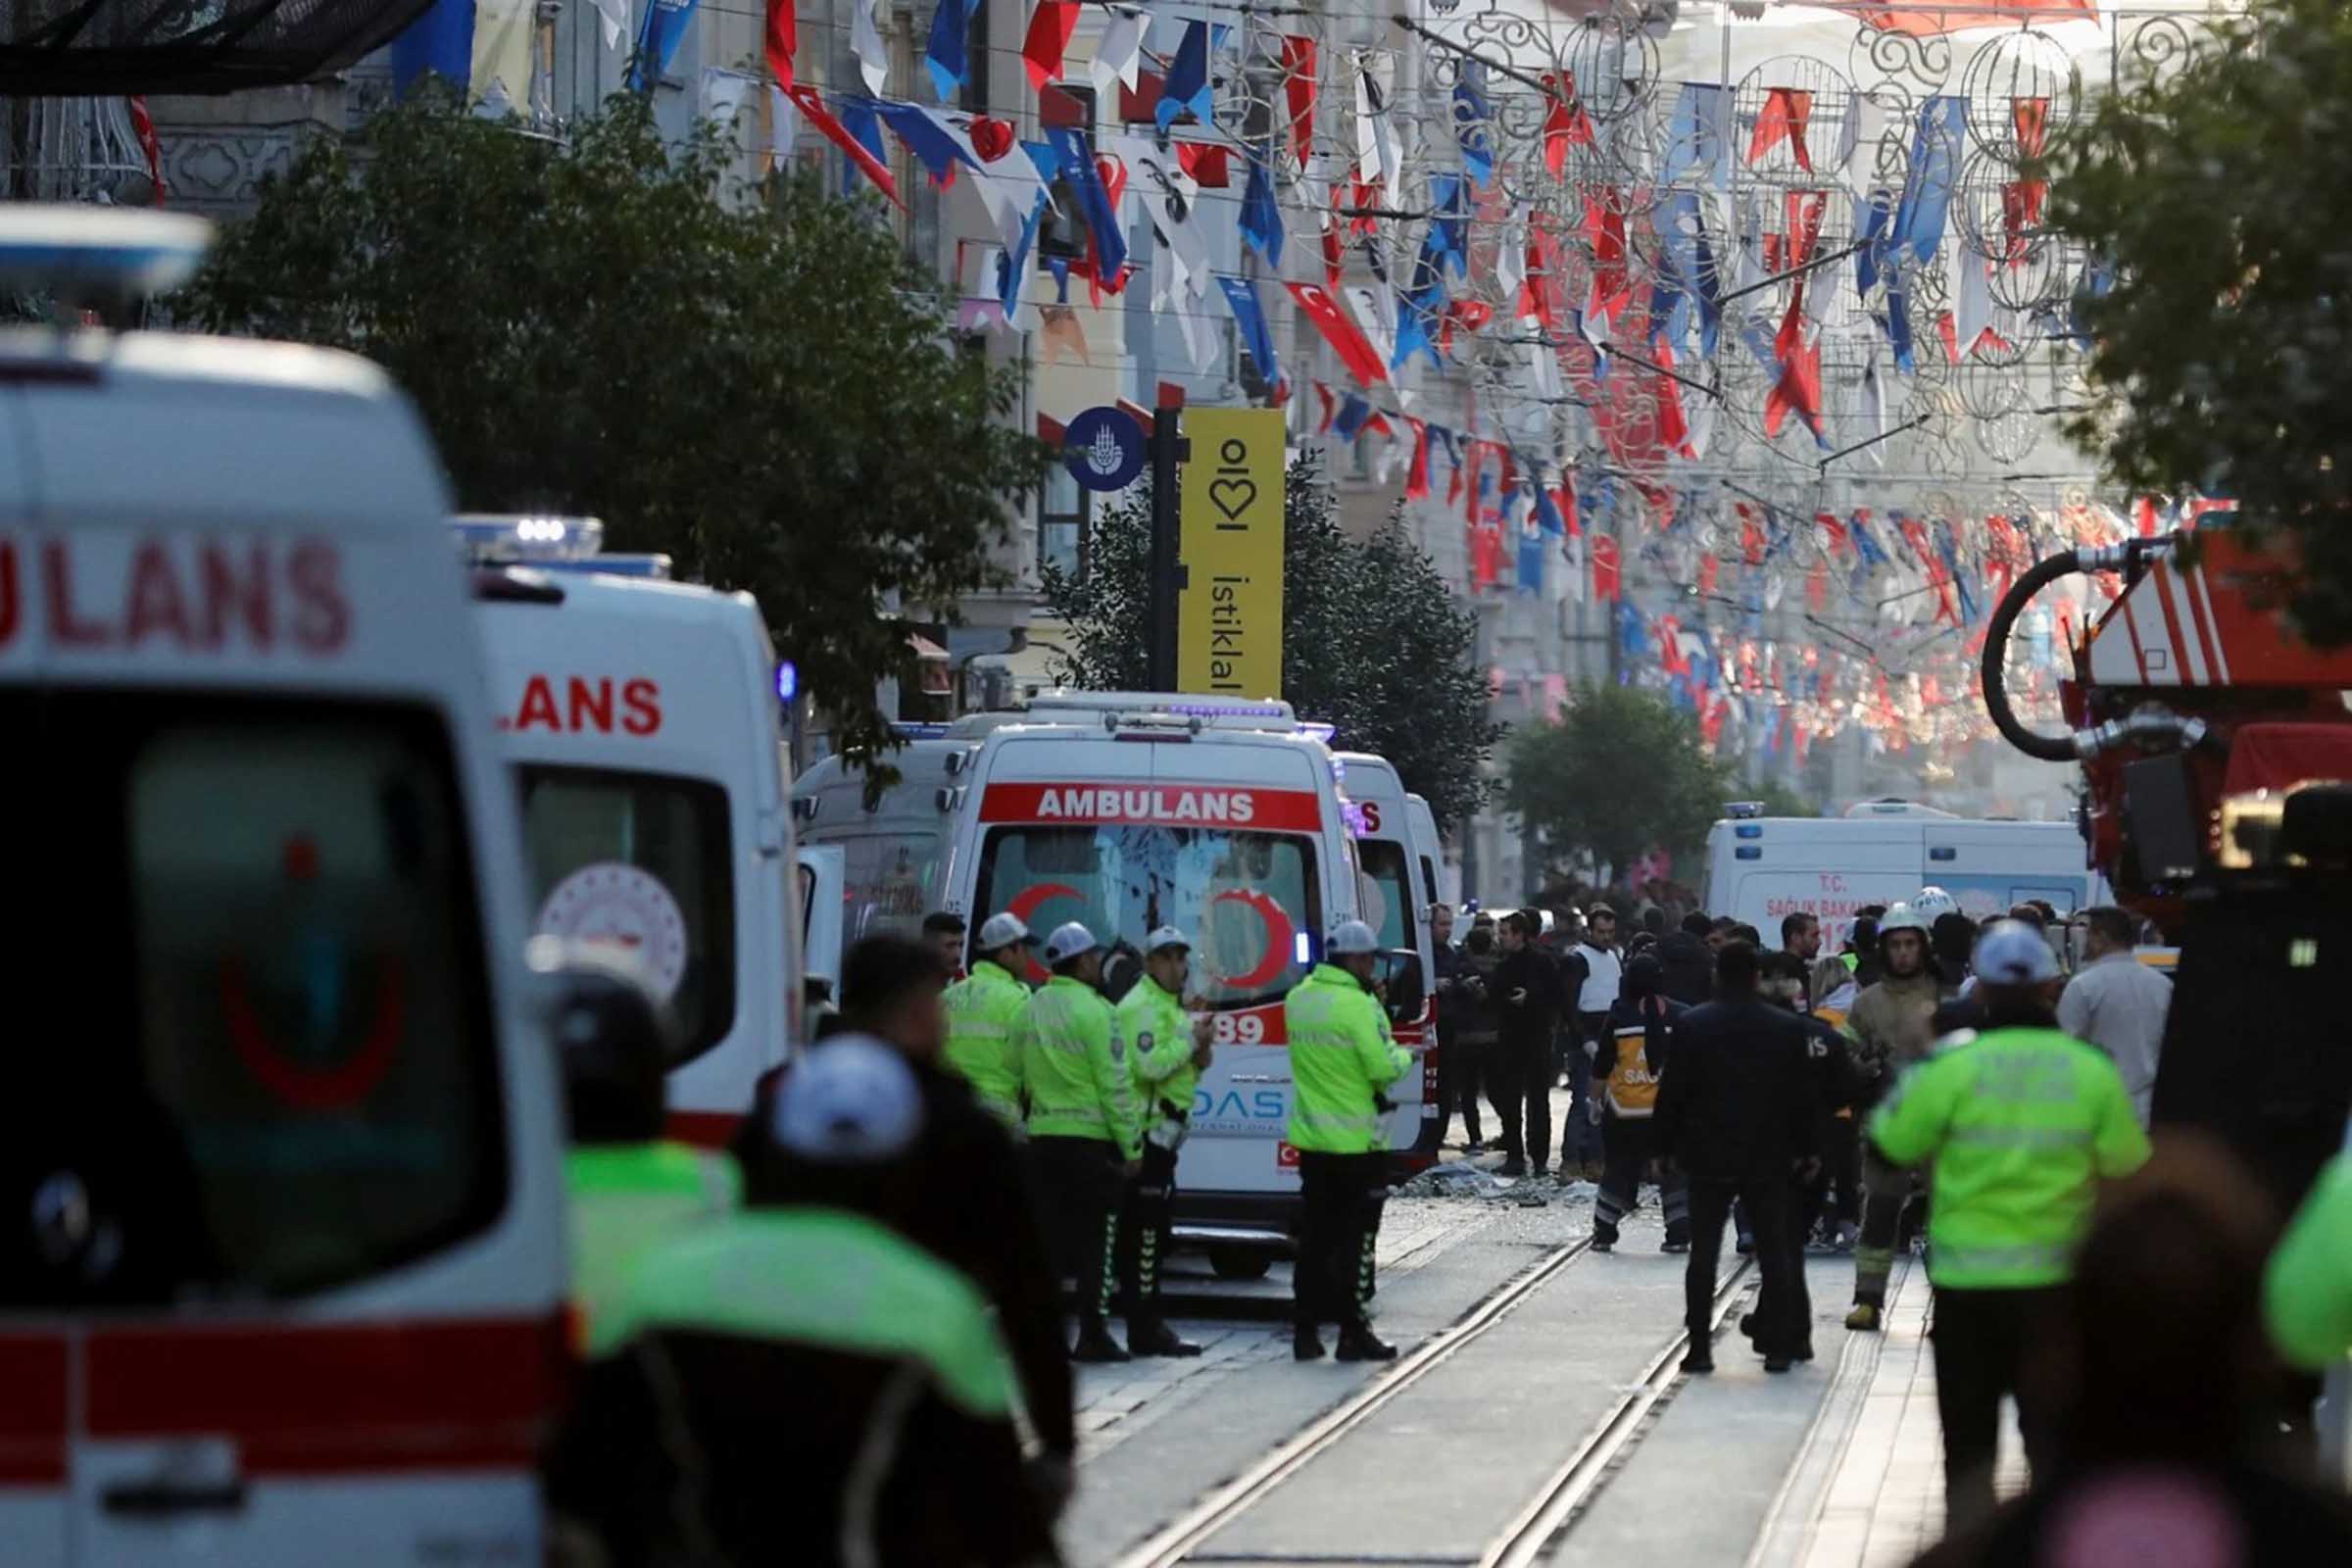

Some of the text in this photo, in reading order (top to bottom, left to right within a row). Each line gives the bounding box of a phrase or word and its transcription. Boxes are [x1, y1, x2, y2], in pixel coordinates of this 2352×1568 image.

[495, 672, 662, 738] ANS
[1037, 788, 1254, 822] AMBULANS
[1190, 1011, 1265, 1045] 89
